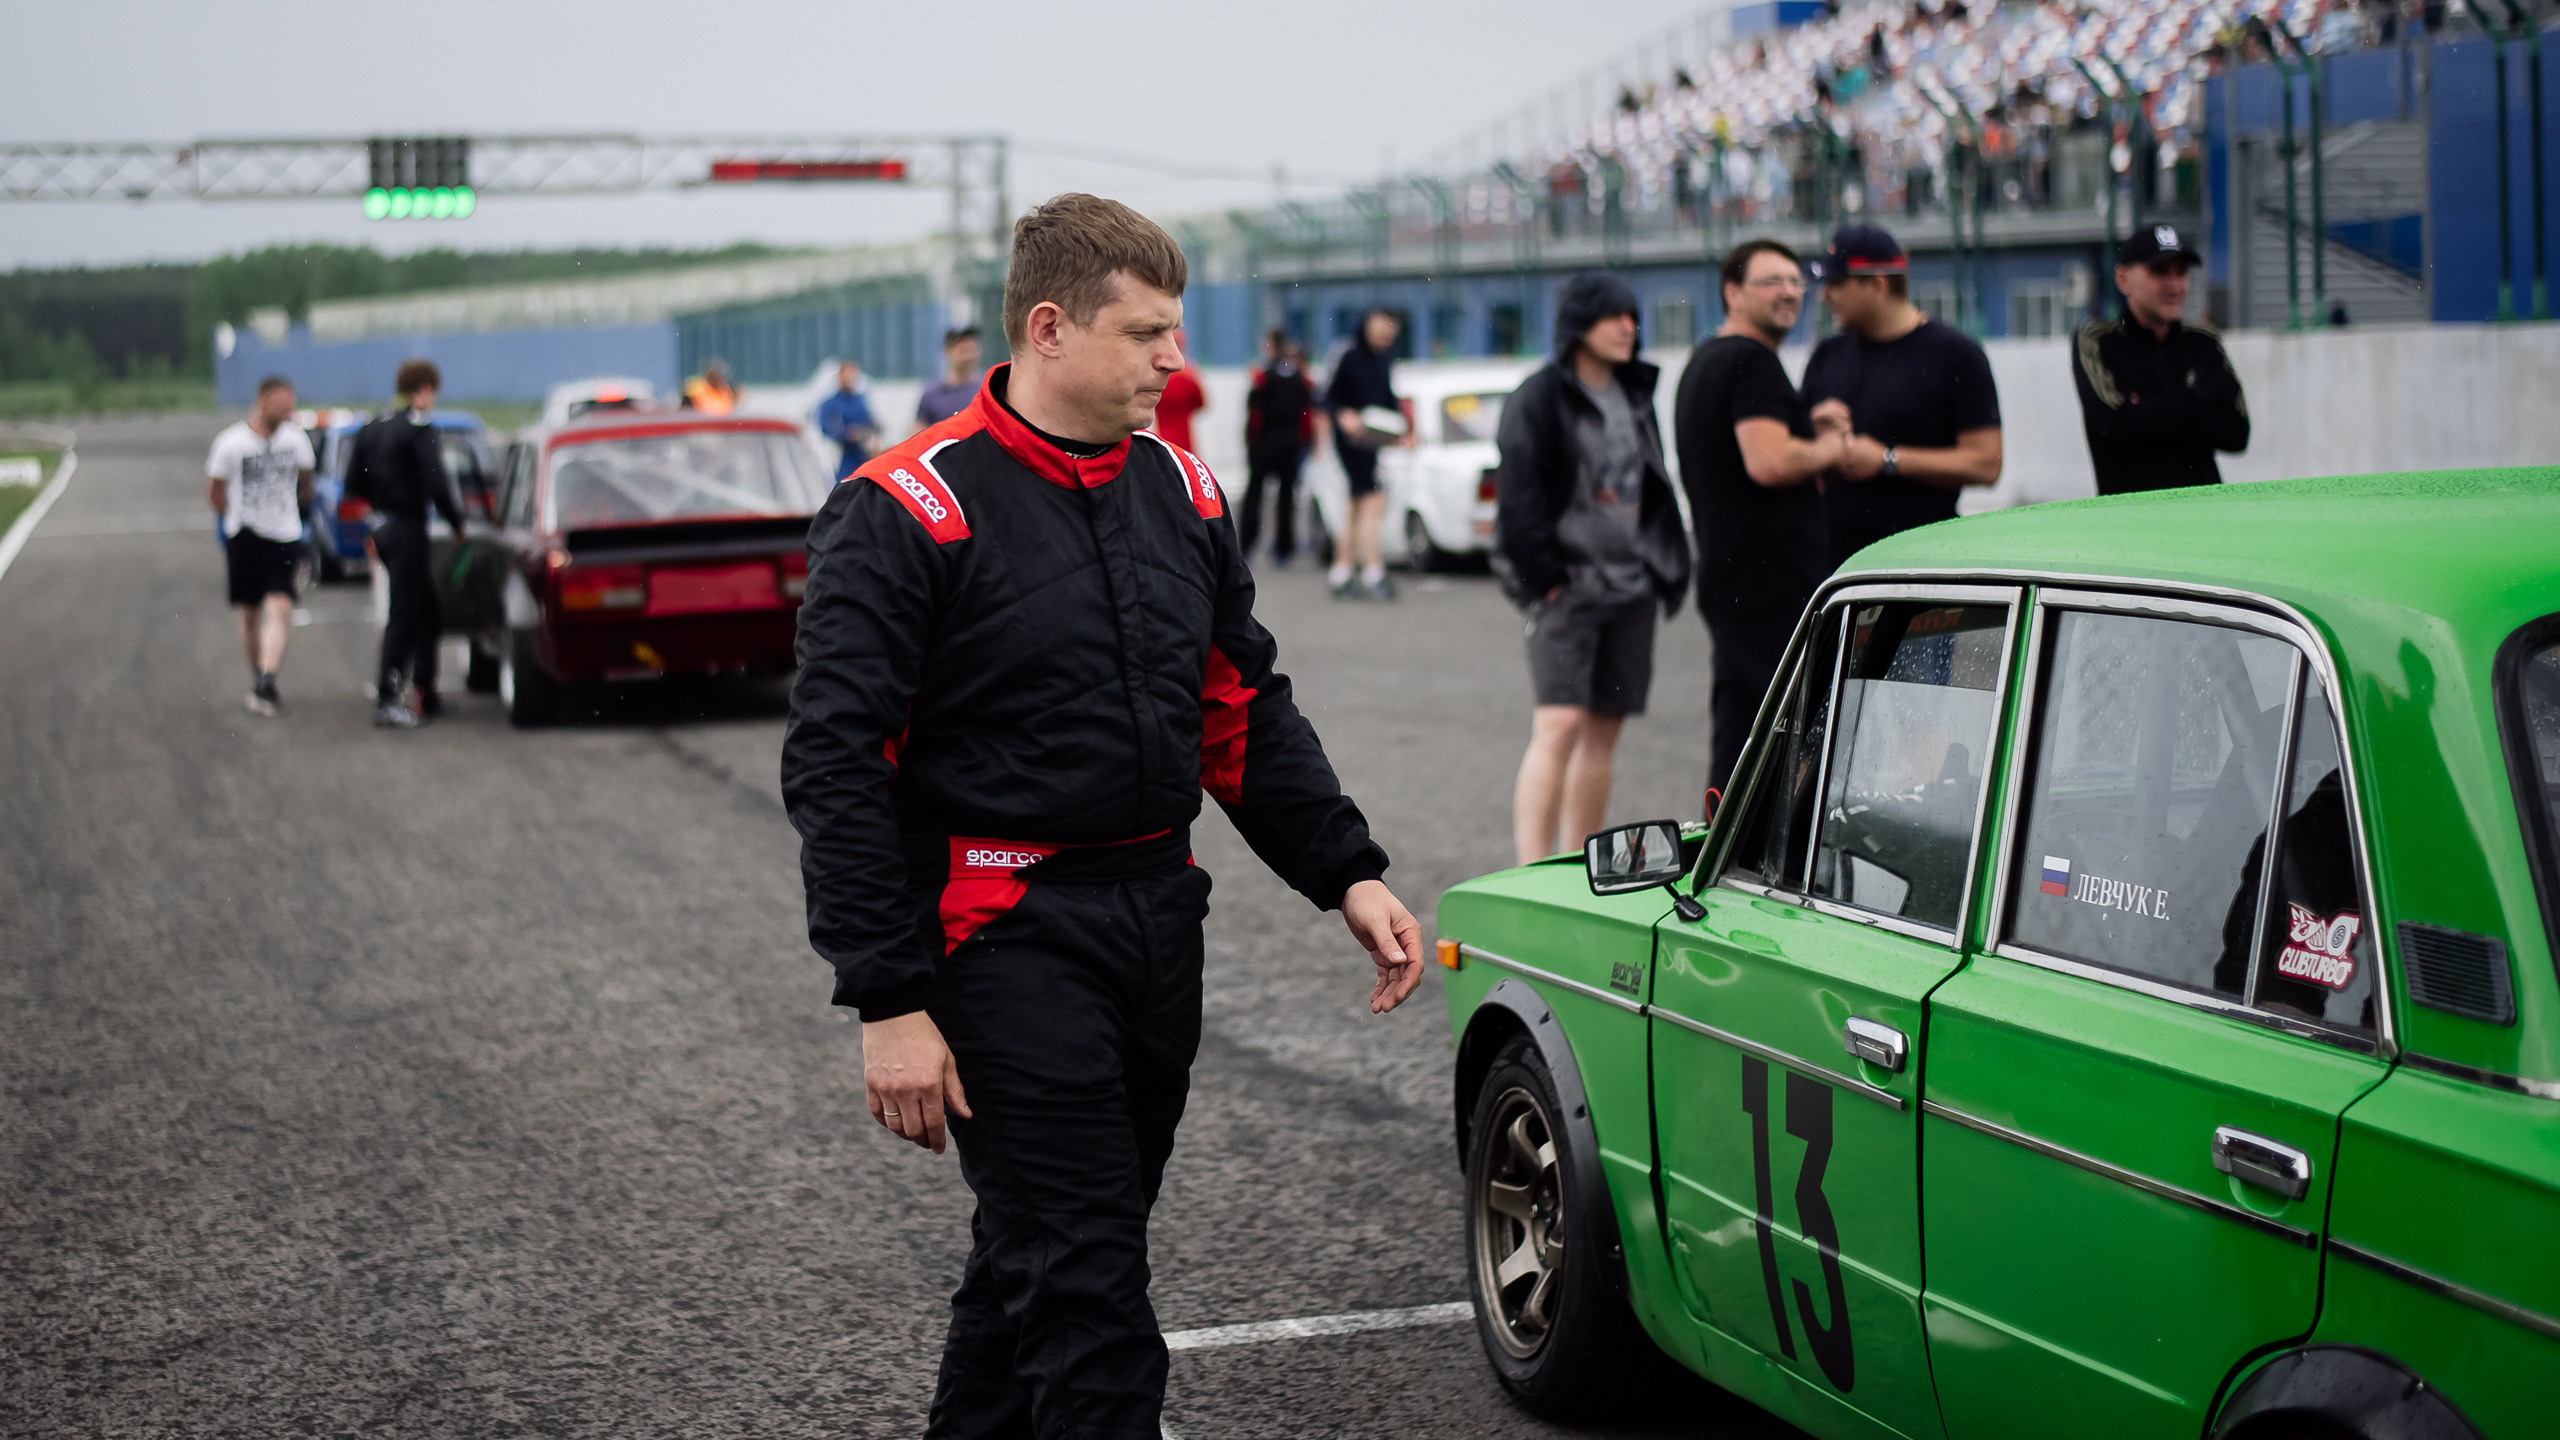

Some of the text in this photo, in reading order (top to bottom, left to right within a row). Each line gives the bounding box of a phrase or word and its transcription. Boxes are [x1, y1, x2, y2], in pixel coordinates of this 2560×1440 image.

[888, 468, 947, 523] sparco
[2074, 873, 2170, 921] ЛЕВЧУК Е.
[2279, 947, 2352, 985] CLUBTURBO
[1742, 1054, 1855, 1394] 13
